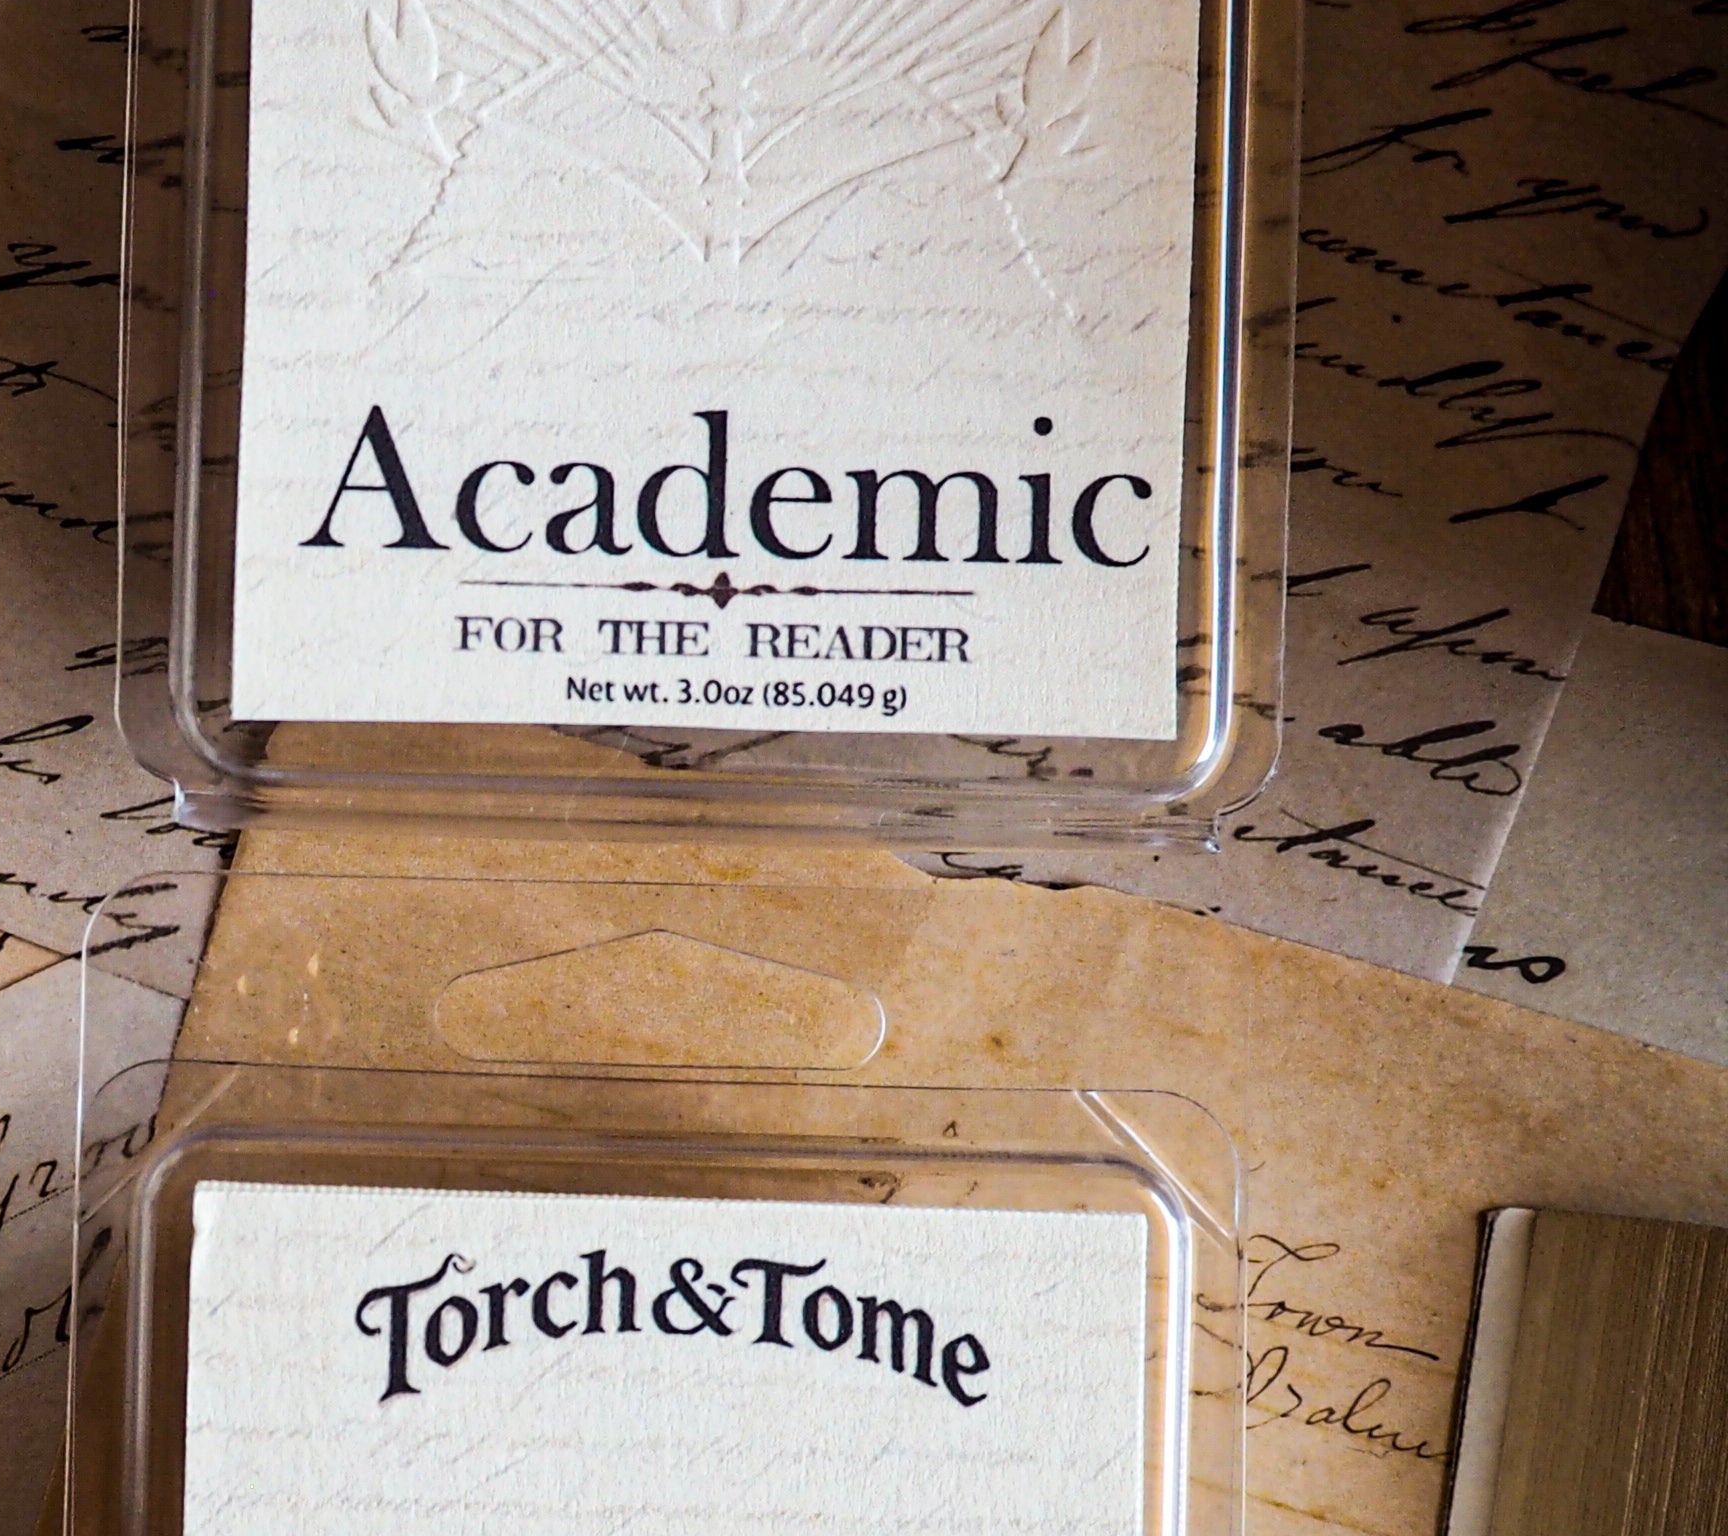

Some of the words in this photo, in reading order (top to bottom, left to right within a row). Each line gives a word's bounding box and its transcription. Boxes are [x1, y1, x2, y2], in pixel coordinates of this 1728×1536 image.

[299, 405, 1152, 567] Academic
[458, 617, 562, 652] FOR
[599, 620, 708, 656] THE
[747, 624, 968, 662] READER
[565, 675, 616, 704] Net
[622, 681, 670, 705] wt.
[676, 677, 755, 707] 3.0oz
[355, 1249, 990, 1407] Torch&Tome
